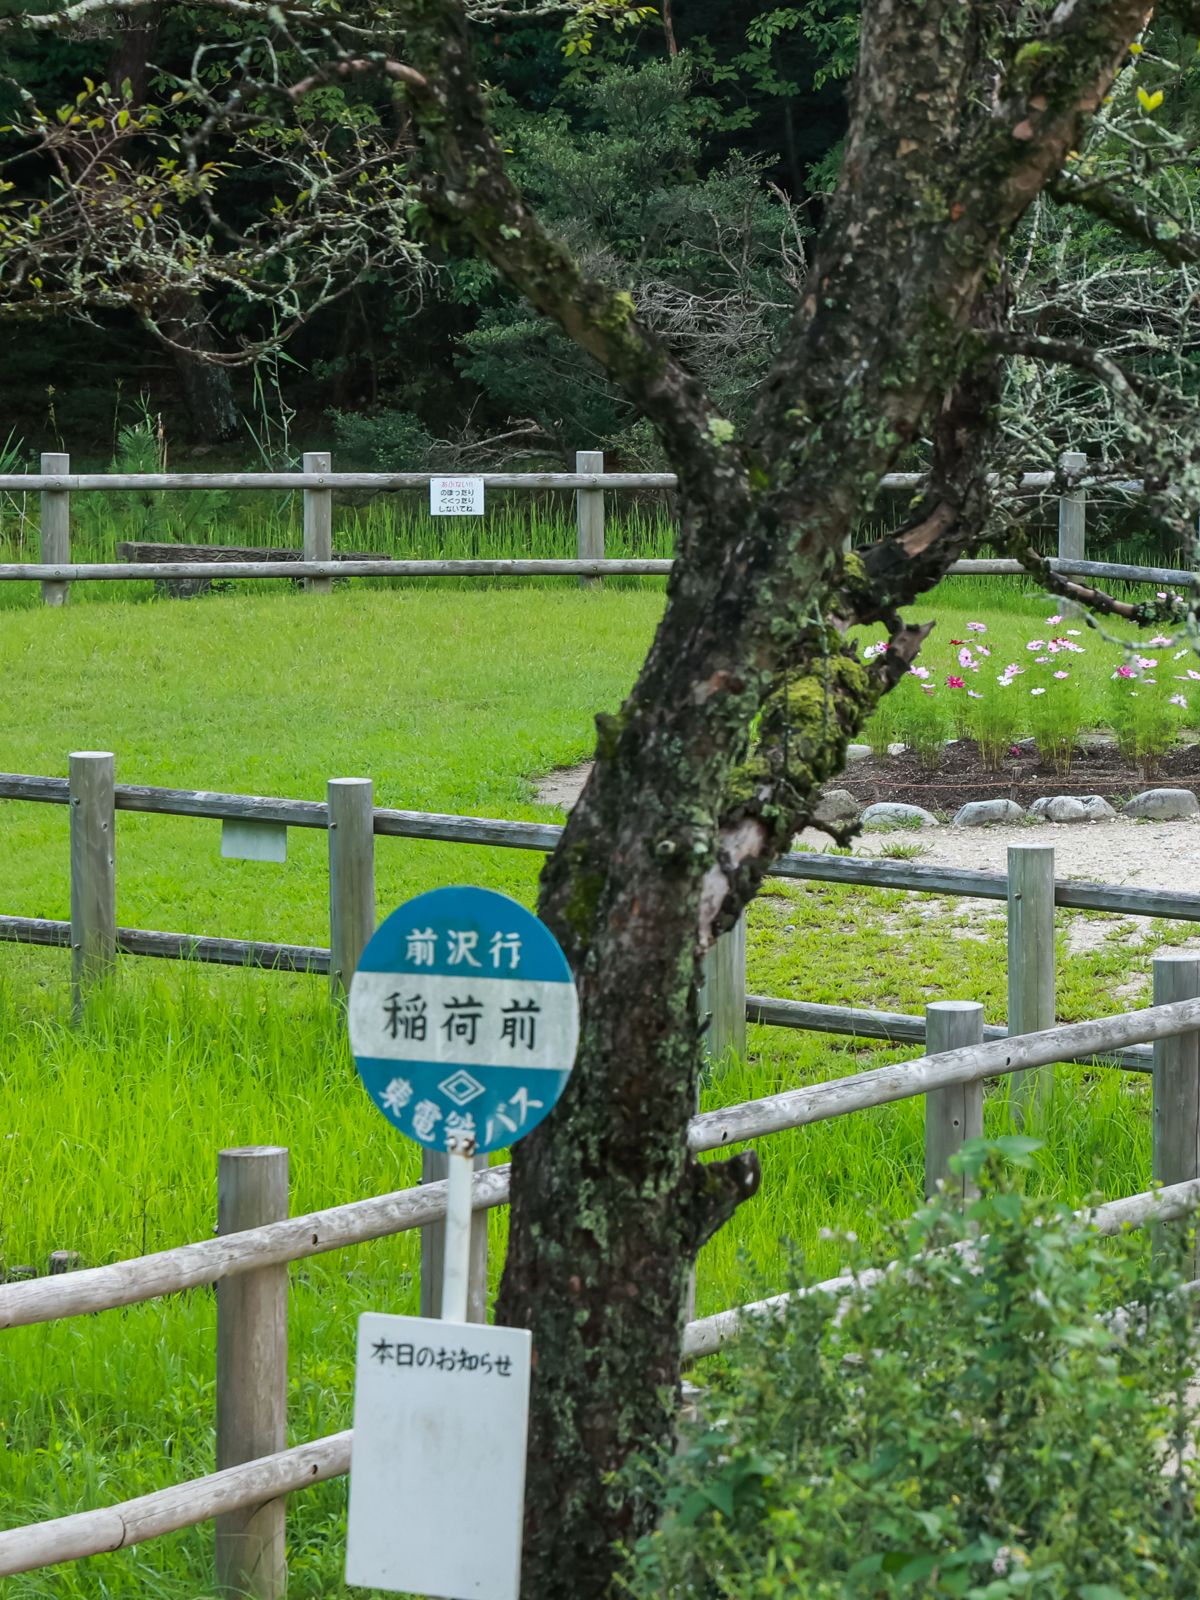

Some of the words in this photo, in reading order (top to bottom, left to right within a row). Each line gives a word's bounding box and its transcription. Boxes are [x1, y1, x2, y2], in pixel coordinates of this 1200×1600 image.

[405, 927, 523, 969] 前沢行
[382, 991, 542, 1051] 稲荷前
[371, 1338, 512, 1378] 本日のお知らせ
